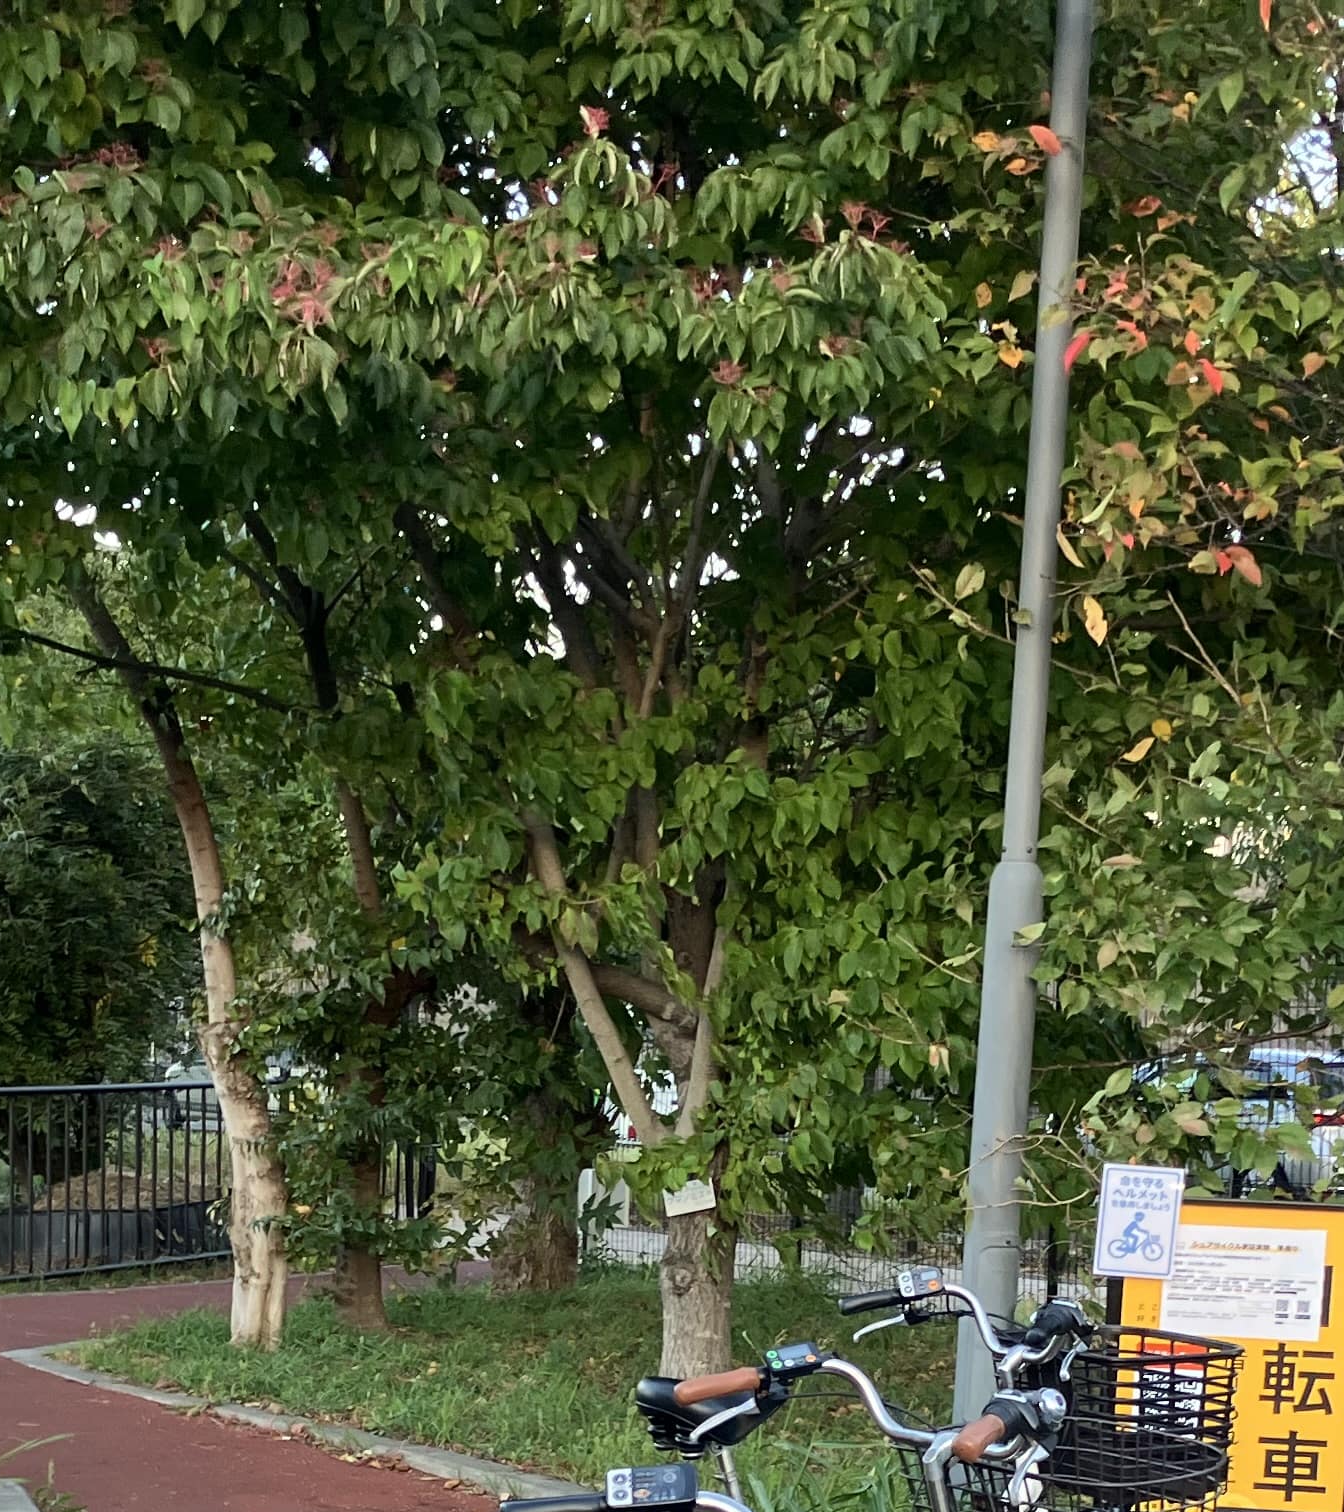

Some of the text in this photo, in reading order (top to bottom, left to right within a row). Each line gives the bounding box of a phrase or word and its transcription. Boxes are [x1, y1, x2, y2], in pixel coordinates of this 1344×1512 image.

[1112, 1188, 1169, 1201] ヘルメット
[1252, 1266, 1335, 1502] 転車
